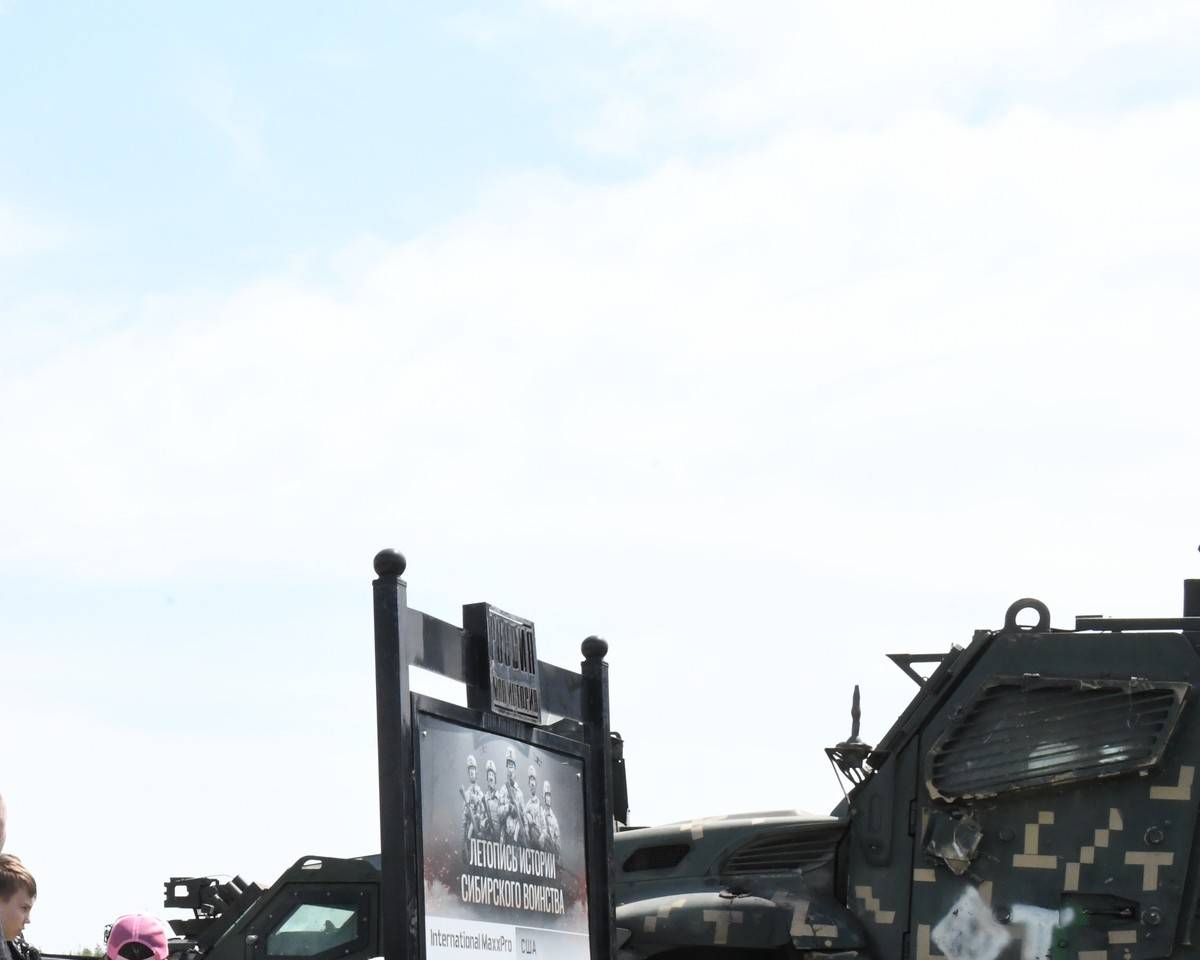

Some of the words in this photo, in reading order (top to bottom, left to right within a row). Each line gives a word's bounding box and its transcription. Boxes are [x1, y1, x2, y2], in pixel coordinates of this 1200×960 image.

[469, 838, 518, 872] ЛЕТОПИСЬ
[519, 847, 557, 880] ИСТОРИИ
[461, 873, 522, 909] СИБИРСКОГО
[523, 883, 565, 915] ВОИНСТВА
[430, 928, 481, 949] International
[481, 933, 513, 953] MaxxPro
[520, 938, 537, 955] США
